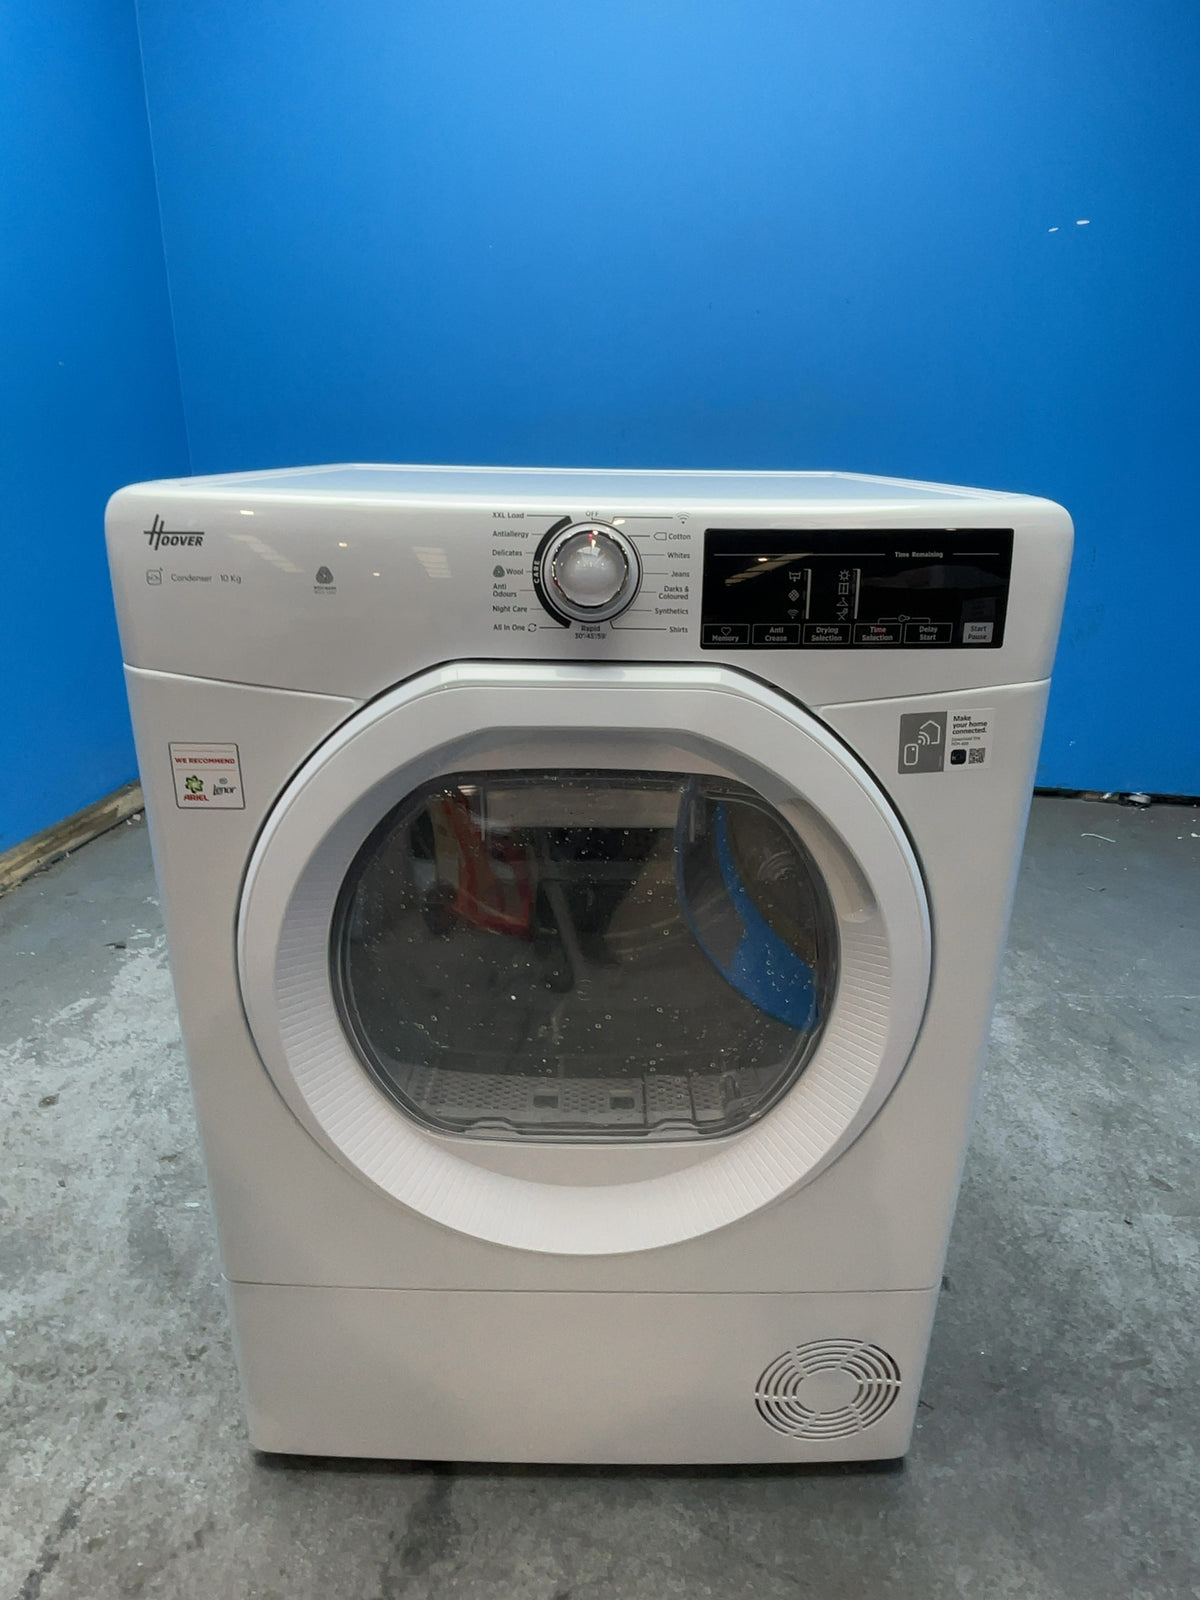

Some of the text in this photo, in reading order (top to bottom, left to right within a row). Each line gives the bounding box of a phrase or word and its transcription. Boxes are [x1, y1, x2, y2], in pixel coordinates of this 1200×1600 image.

[143, 514, 204, 550] HOOVER
[493, 531, 529, 539] Antiallergy
[912, 551, 943, 559] Remaining
[231, 575, 241, 584] Kg
[493, 590, 517, 598] Odours
[655, 608, 689, 616] Synthetics
[581, 625, 600, 633] Rapid
[816, 626, 839, 635] Drying
[919, 626, 938, 635] Delay
[712, 635, 739, 643] Memory
[811, 634, 842, 642] Selection
[862, 634, 893, 642] Selection
[920, 633, 937, 641] Start
